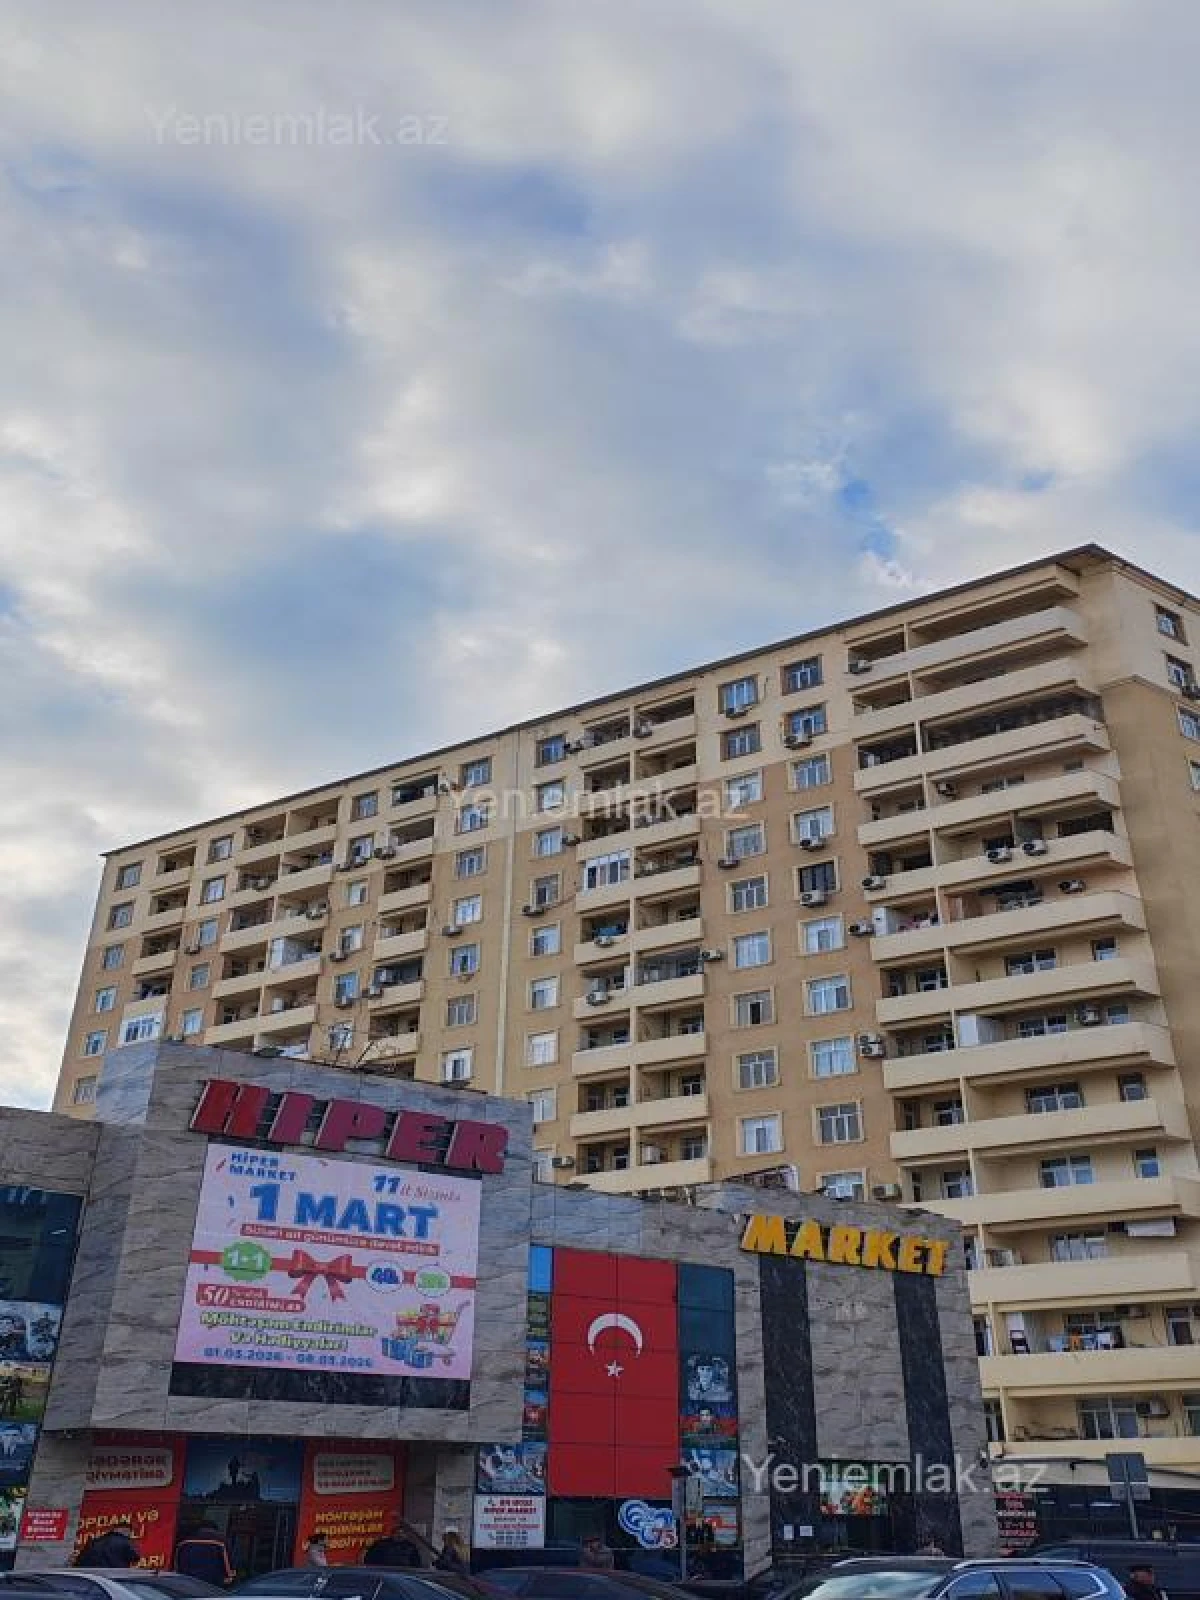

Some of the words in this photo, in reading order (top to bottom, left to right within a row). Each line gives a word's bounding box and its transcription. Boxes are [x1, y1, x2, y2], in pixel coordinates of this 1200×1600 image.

[229, 1163, 297, 1182] MARKET
[250, 1184, 281, 1222] 1
[294, 1191, 439, 1240] MART
[739, 1214, 949, 1277] MARKET
